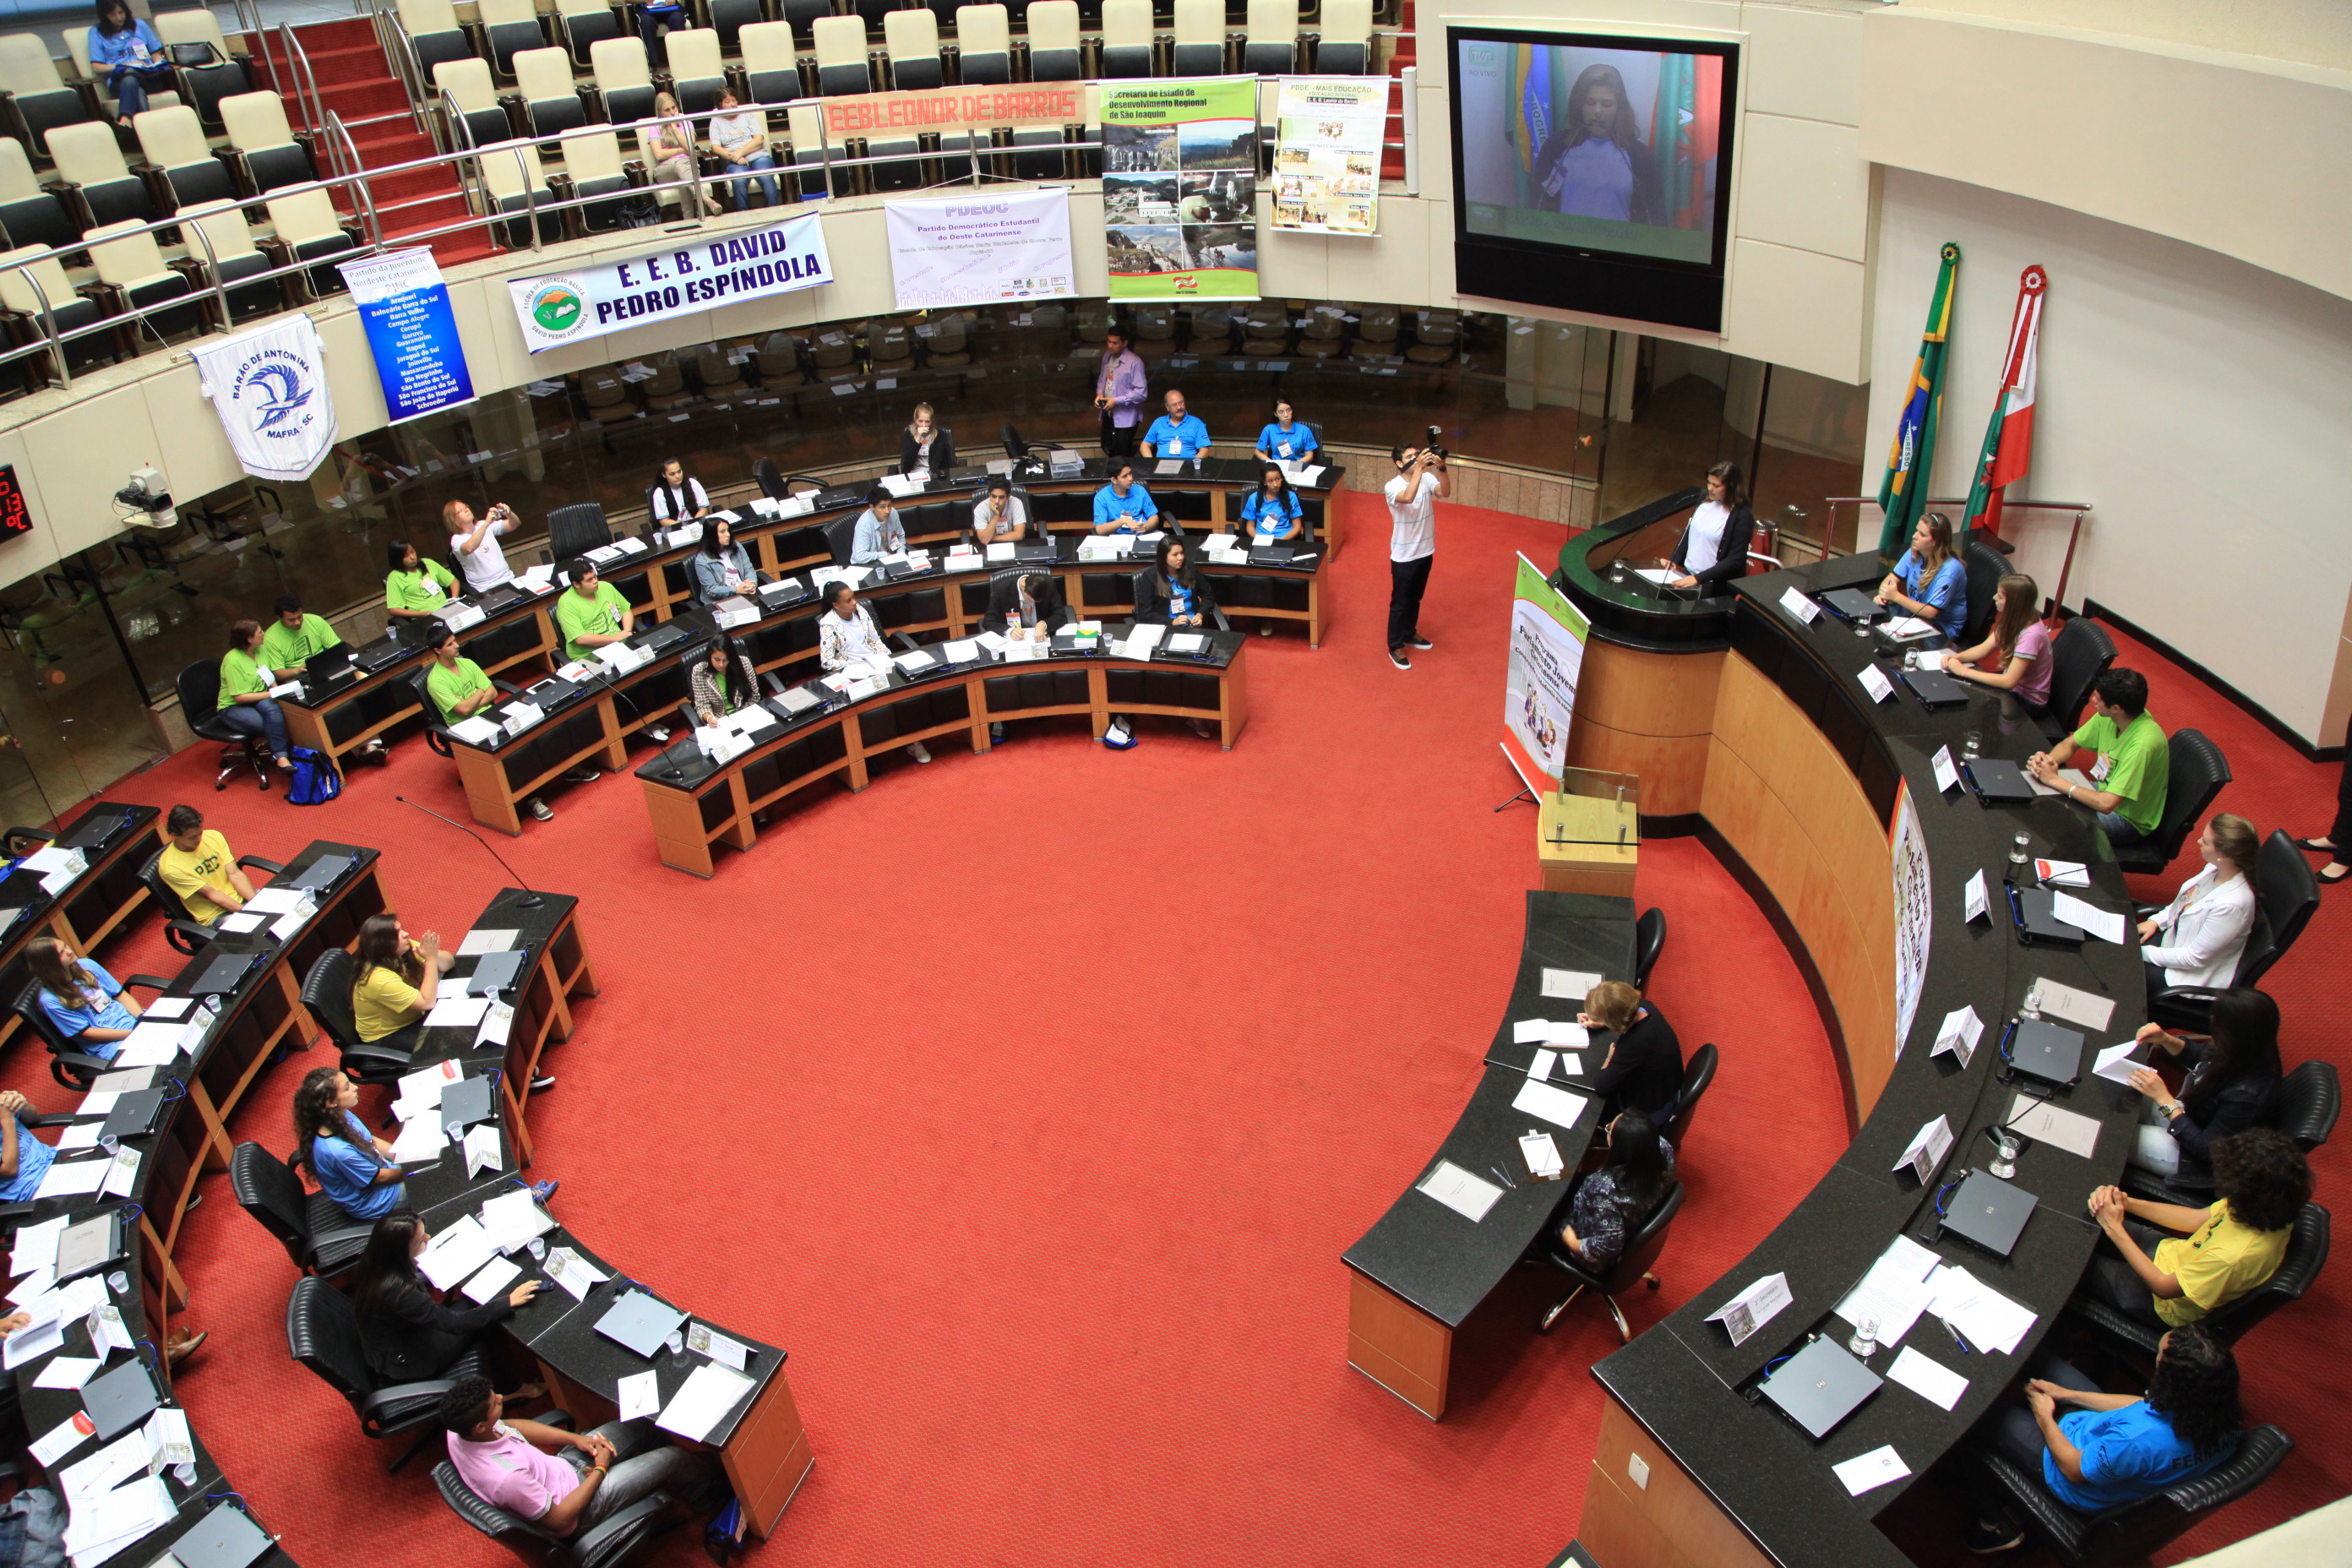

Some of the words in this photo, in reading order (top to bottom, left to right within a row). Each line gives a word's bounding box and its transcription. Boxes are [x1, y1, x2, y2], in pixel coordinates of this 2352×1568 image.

[1149, 90, 1158, 98] de
[1159, 88, 1184, 97] Estado
[1185, 88, 1195, 96] de
[962, 95, 991, 122] DE
[993, 90, 1076, 120] BARROS
[1109, 100, 1173, 109] Desenvolvimento
[1174, 98, 1206, 108] Regional
[1120, 111, 1134, 119] São
[1135, 111, 1166, 119] Joaquim
[945, 201, 1009, 218] PDEOC
[948, 221, 998, 231] Democrático
[1000, 218, 1040, 226] Estudantil
[975, 230, 1022, 238] Catarinense
[617, 264, 640, 288] E.
[646, 257, 669, 282] E.
[674, 251, 701, 275] B.
[709, 230, 787, 267] DAVID
[348, 268, 377, 279] Partido
[389, 255, 427, 272] Juventude
[353, 275, 387, 288] Nordeste
[388, 264, 432, 280] Catarinense
[524, 290, 535, 309] ESCOLA
[541, 277, 568, 286] EDUCAÇÃO
[596, 286, 680, 324] PEDRO
[685, 253, 822, 304] ESPÍNDOLA
[390, 292, 417, 305] Araquari
[371, 304, 402, 318] Balneário
[402, 301, 419, 310] Barra
[389, 312, 407, 321] Barra
[407, 308, 425, 316] Velha
[388, 319, 409, 328] Campo
[411, 313, 429, 324] Alegre
[400, 323, 422, 333] Corupá
[402, 330, 424, 340] Garuva
[532, 325, 547, 338] DAVID
[396, 334, 433, 347] Guaramirim
[406, 341, 426, 353] Itapoá
[397, 351, 421, 363] Jaraguá
[407, 357, 433, 368] Joinville
[232, 363, 250, 400] BARÃO
[250, 353, 262, 365] DE
[264, 350, 309, 373] ANTONINA
[400, 361, 444, 377] Massaranduba
[416, 368, 443, 382] Negrinho
[411, 385, 438, 397] Francisco
[447, 378, 456, 387] Sul
[413, 380, 431, 389] Bento
[400, 399, 412, 407] São
[412, 394, 426, 406] João
[417, 397, 446, 411] Schroeder
[267, 427, 300, 439] MAFRA
[302, 413, 314, 426] SC
[1535, 634, 1558, 666] Programa
[1519, 624, 1551, 670] Parlamento
[1553, 667, 1576, 694] Jovem
[1531, 649, 1560, 689] Catarinense
[194, 857, 220, 875] PEC
